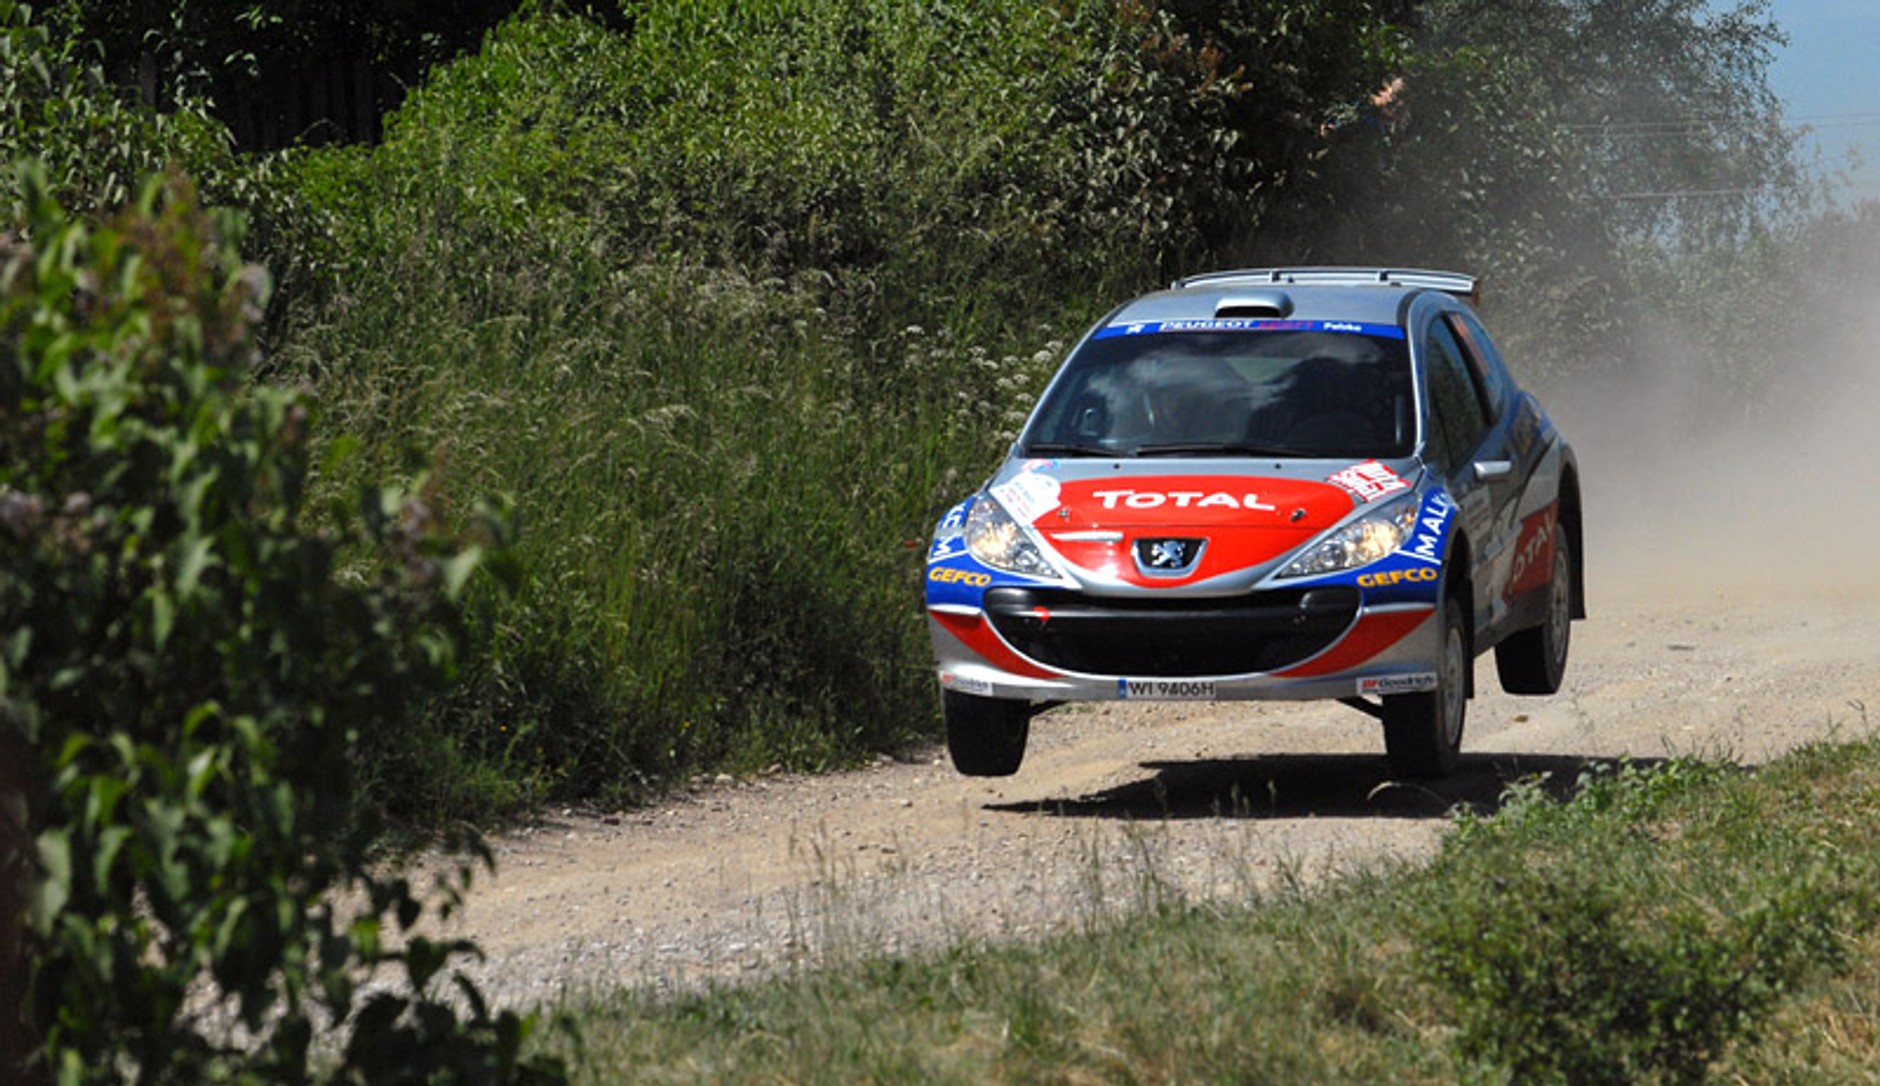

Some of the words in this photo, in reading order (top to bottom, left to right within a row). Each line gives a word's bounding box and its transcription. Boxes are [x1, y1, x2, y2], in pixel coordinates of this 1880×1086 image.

[1093, 490, 1275, 511] TOTAL
[929, 566, 991, 587] GEFCO
[1357, 567, 1438, 588] GEFCO
[1127, 682, 1152, 695] WI
